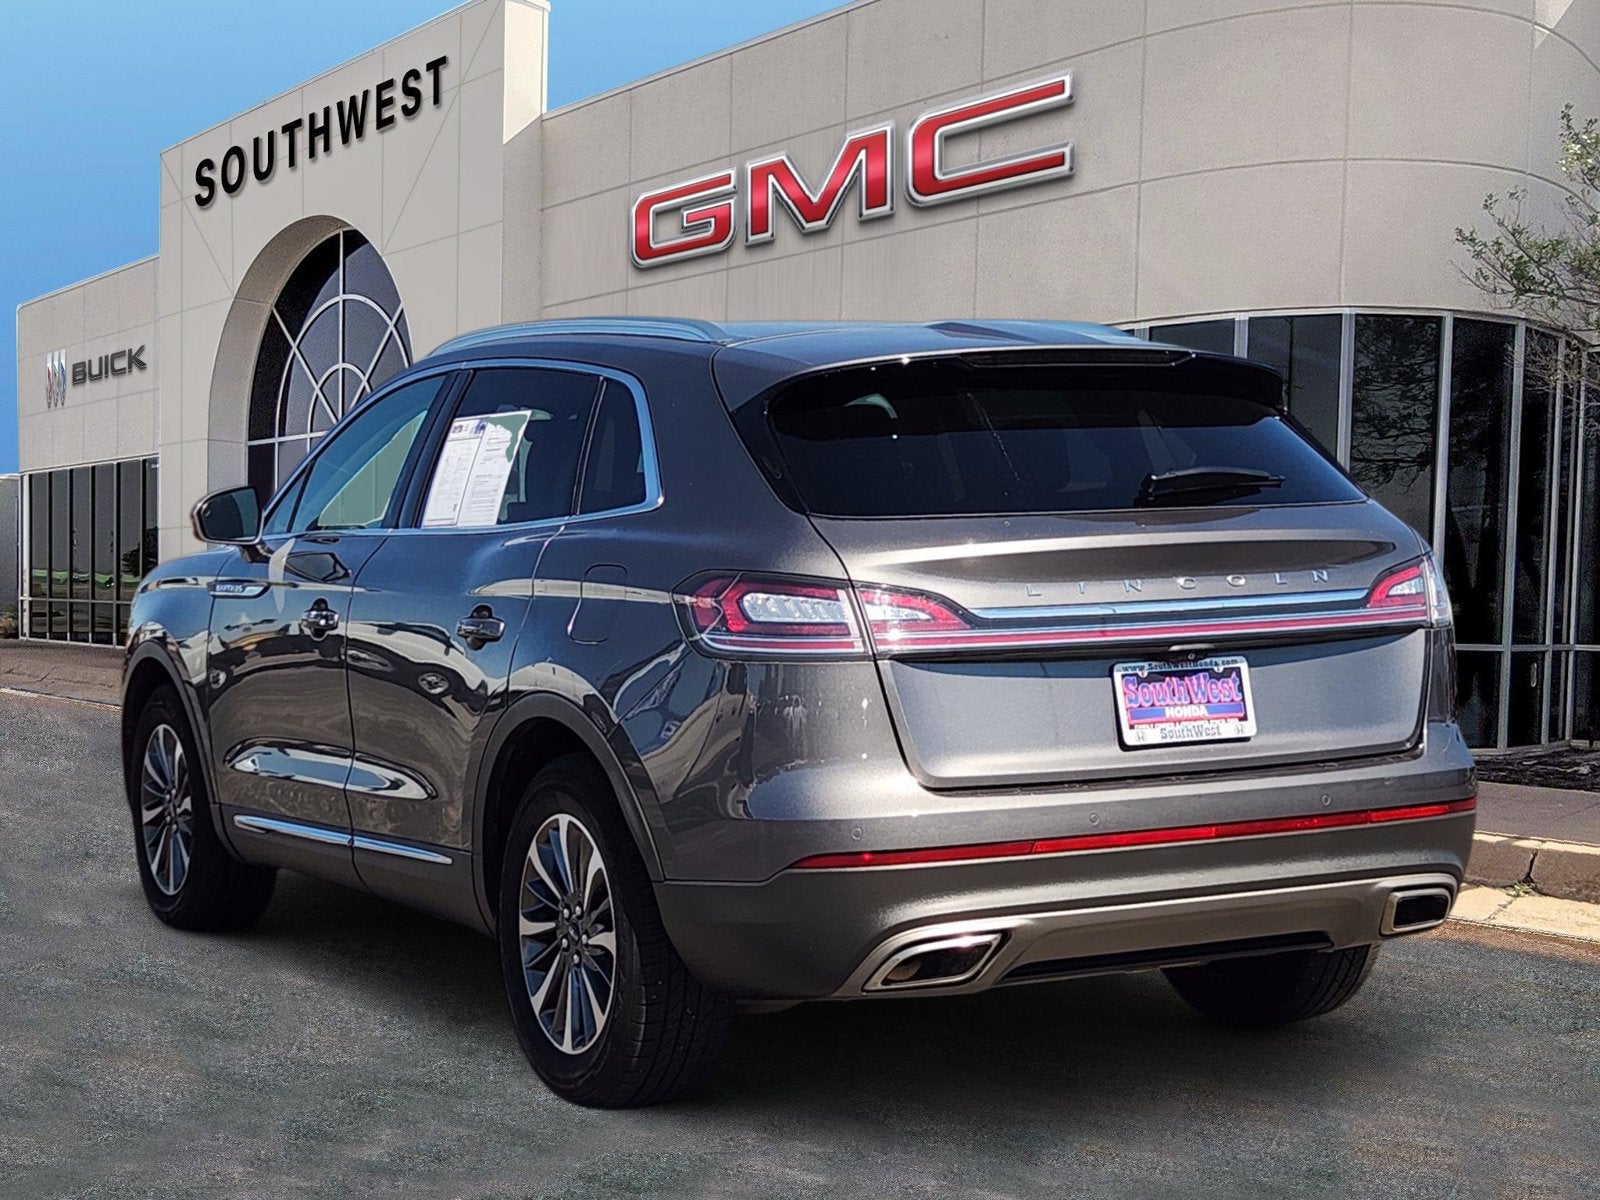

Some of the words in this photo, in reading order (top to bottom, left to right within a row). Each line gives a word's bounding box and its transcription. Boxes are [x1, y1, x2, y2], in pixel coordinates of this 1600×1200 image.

[194, 55, 448, 208] SOUTHWEST
[629, 68, 1076, 270] GMC
[71, 344, 148, 386] BUICK
[1026, 570, 1329, 597] LINCOLN
[1123, 671, 1242, 707] SouthWest
[1165, 704, 1208, 718] HONDA
[1160, 724, 1222, 741] SouthWest
